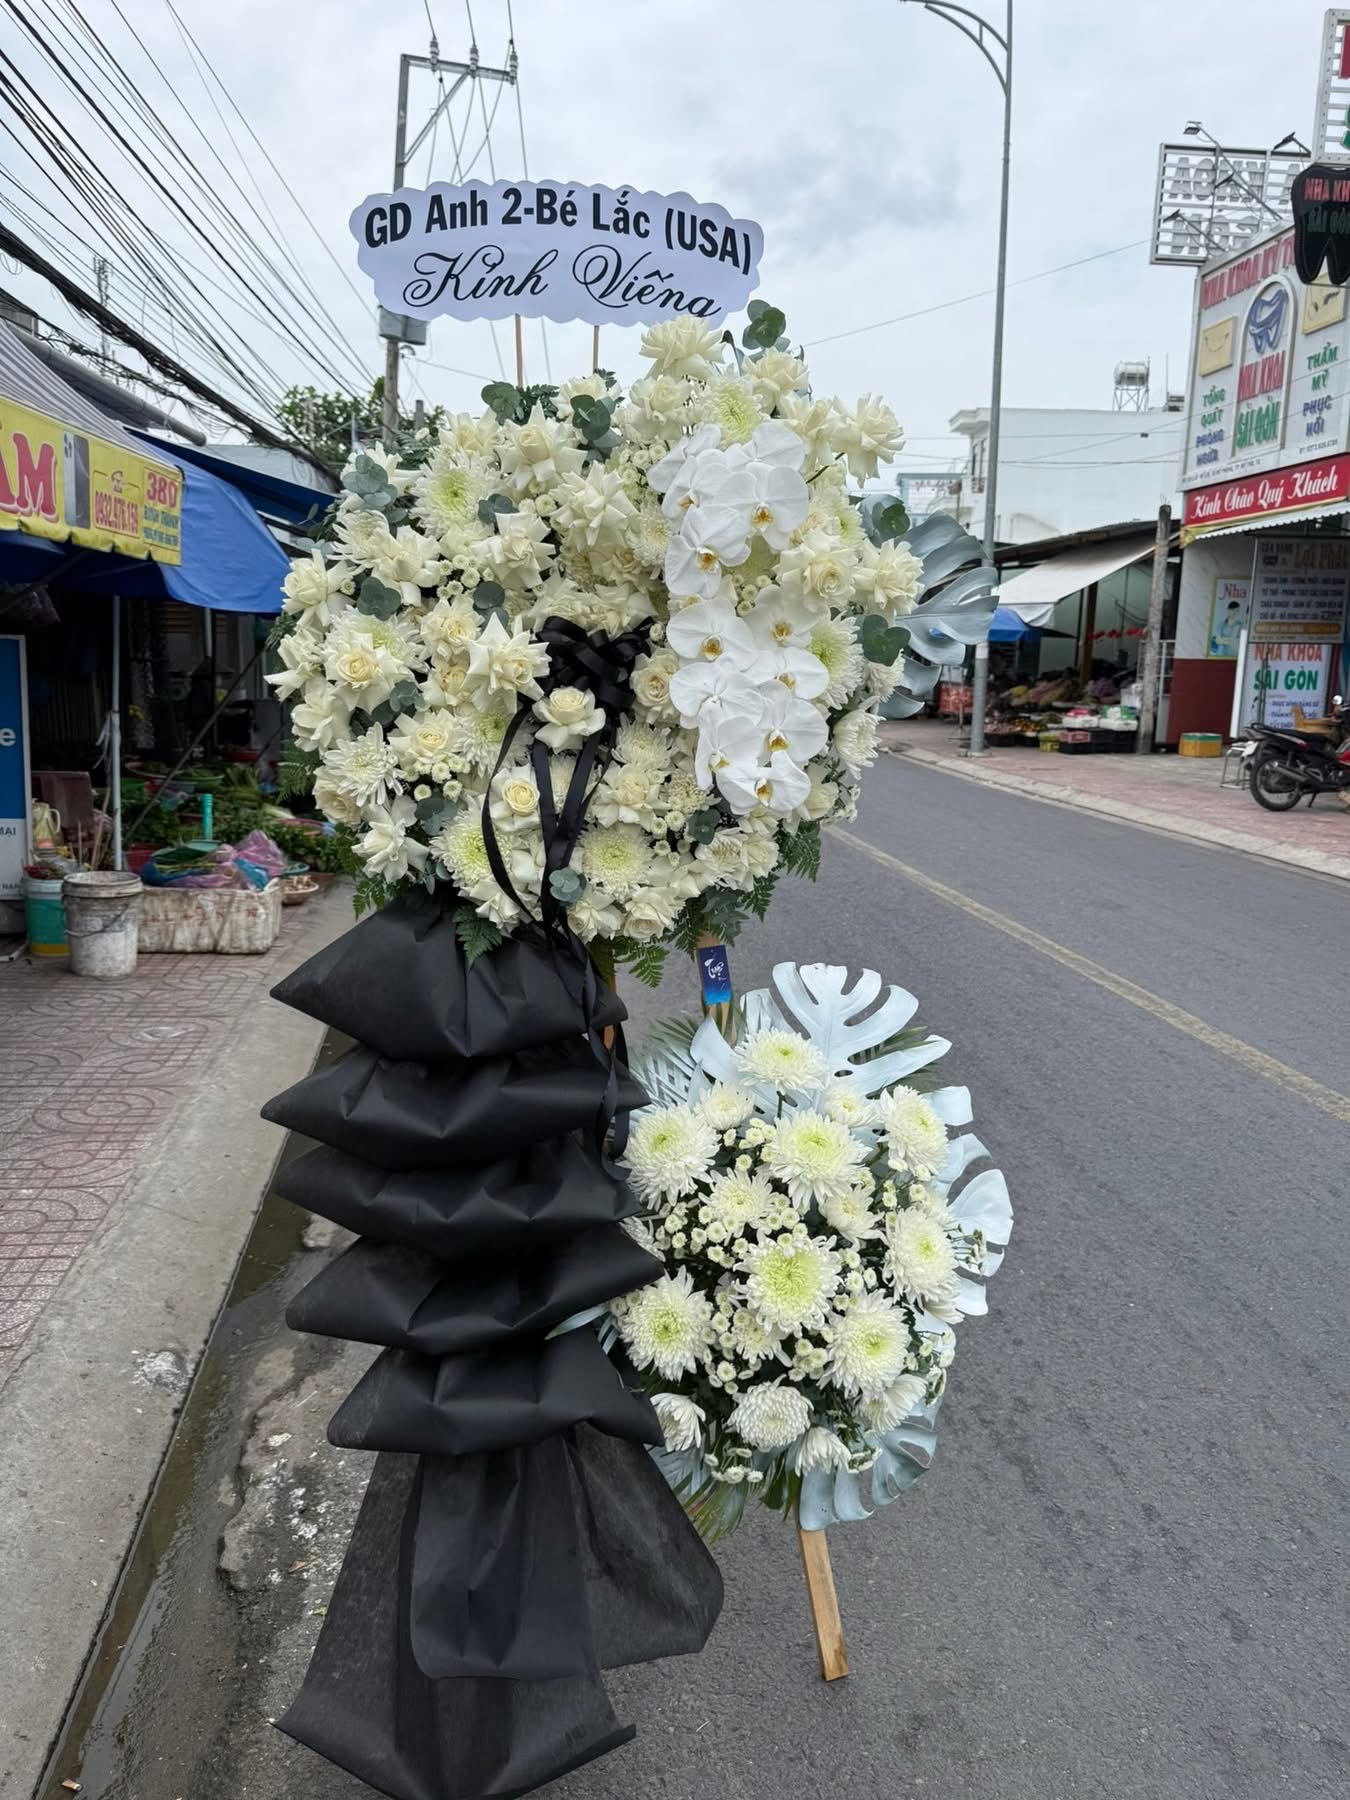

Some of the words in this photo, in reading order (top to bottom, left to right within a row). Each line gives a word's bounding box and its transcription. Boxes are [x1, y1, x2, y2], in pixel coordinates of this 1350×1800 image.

[364, 203, 412, 249] GD
[425, 188, 488, 234] Anh
[501, 186, 578, 228] 2-Bé
[592, 189, 651, 239] Lắc
[664, 207, 751, 276] (USA)
[1307, 341, 1339, 370] THẨM
[1303, 395, 1333, 418] PHỤC
[147, 471, 177, 508] 380
[1191, 492, 1221, 519] Kính
[1224, 487, 1254, 512] Chào
[1258, 479, 1284, 510] Quý
[1288, 464, 1338, 499] Khách
[1255, 642, 1282, 661] NHA
[1287, 642, 1322, 662] KHOA
[1254, 664, 1279, 690] SÀI
[1284, 665, 1319, 690] GÒN
